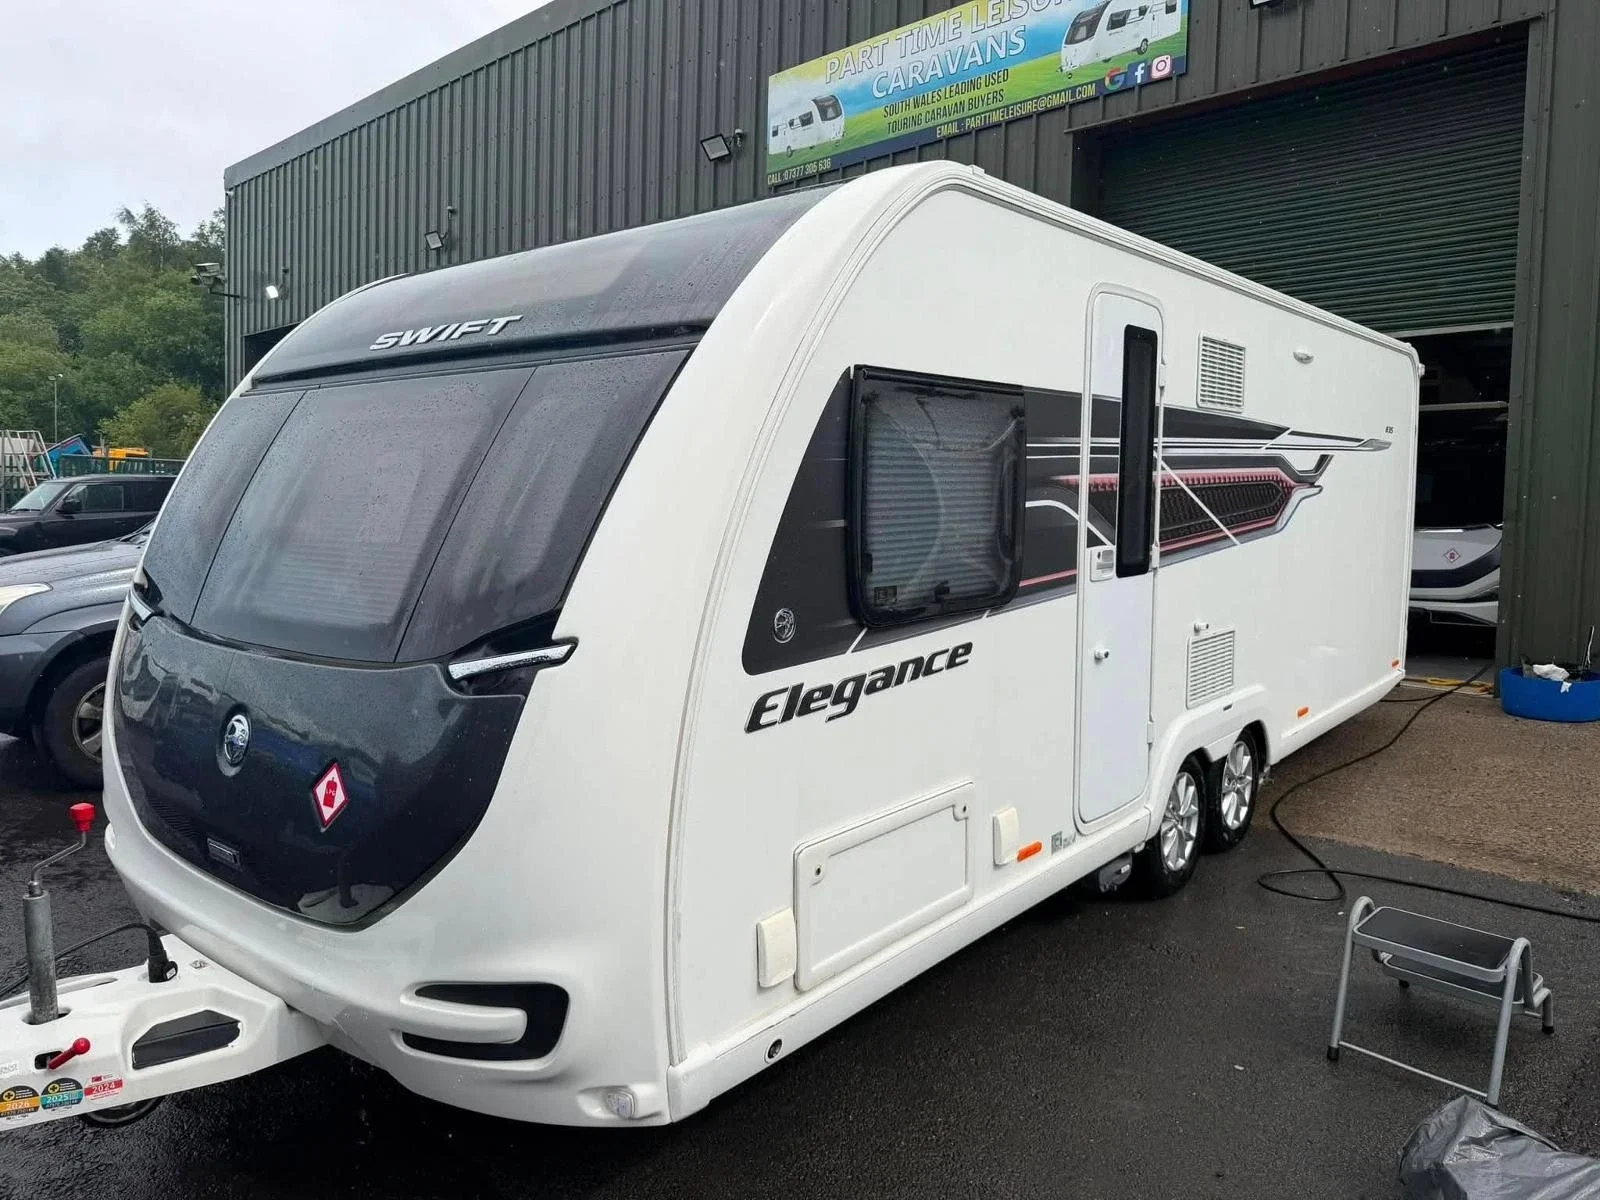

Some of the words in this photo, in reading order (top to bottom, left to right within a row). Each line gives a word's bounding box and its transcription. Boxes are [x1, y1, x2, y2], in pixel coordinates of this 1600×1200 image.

[826, 37, 889, 84] PART
[896, 11, 963, 59] TIME
[872, 25, 1027, 99] CARAVANS
[883, 102, 911, 119] SOUTH
[913, 89, 942, 110] WALES
[944, 76, 982, 100] LEADING
[984, 68, 1009, 88] USED
[887, 113, 923, 135] TOURING
[924, 99, 966, 124] CARAVAN
[967, 88, 1005, 111] BUYERS
[936, 122, 960, 138] EMAIL
[965, 83, 1096, 131] PARTTIMELEISURE@GMAIL.COM
[768, 173, 781, 185] CALL
[369, 314, 524, 350] SWIFT
[744, 641, 973, 734] Elegance
[47, 1093, 70, 1103] 2025
[92, 1082, 115, 1094] 2024
